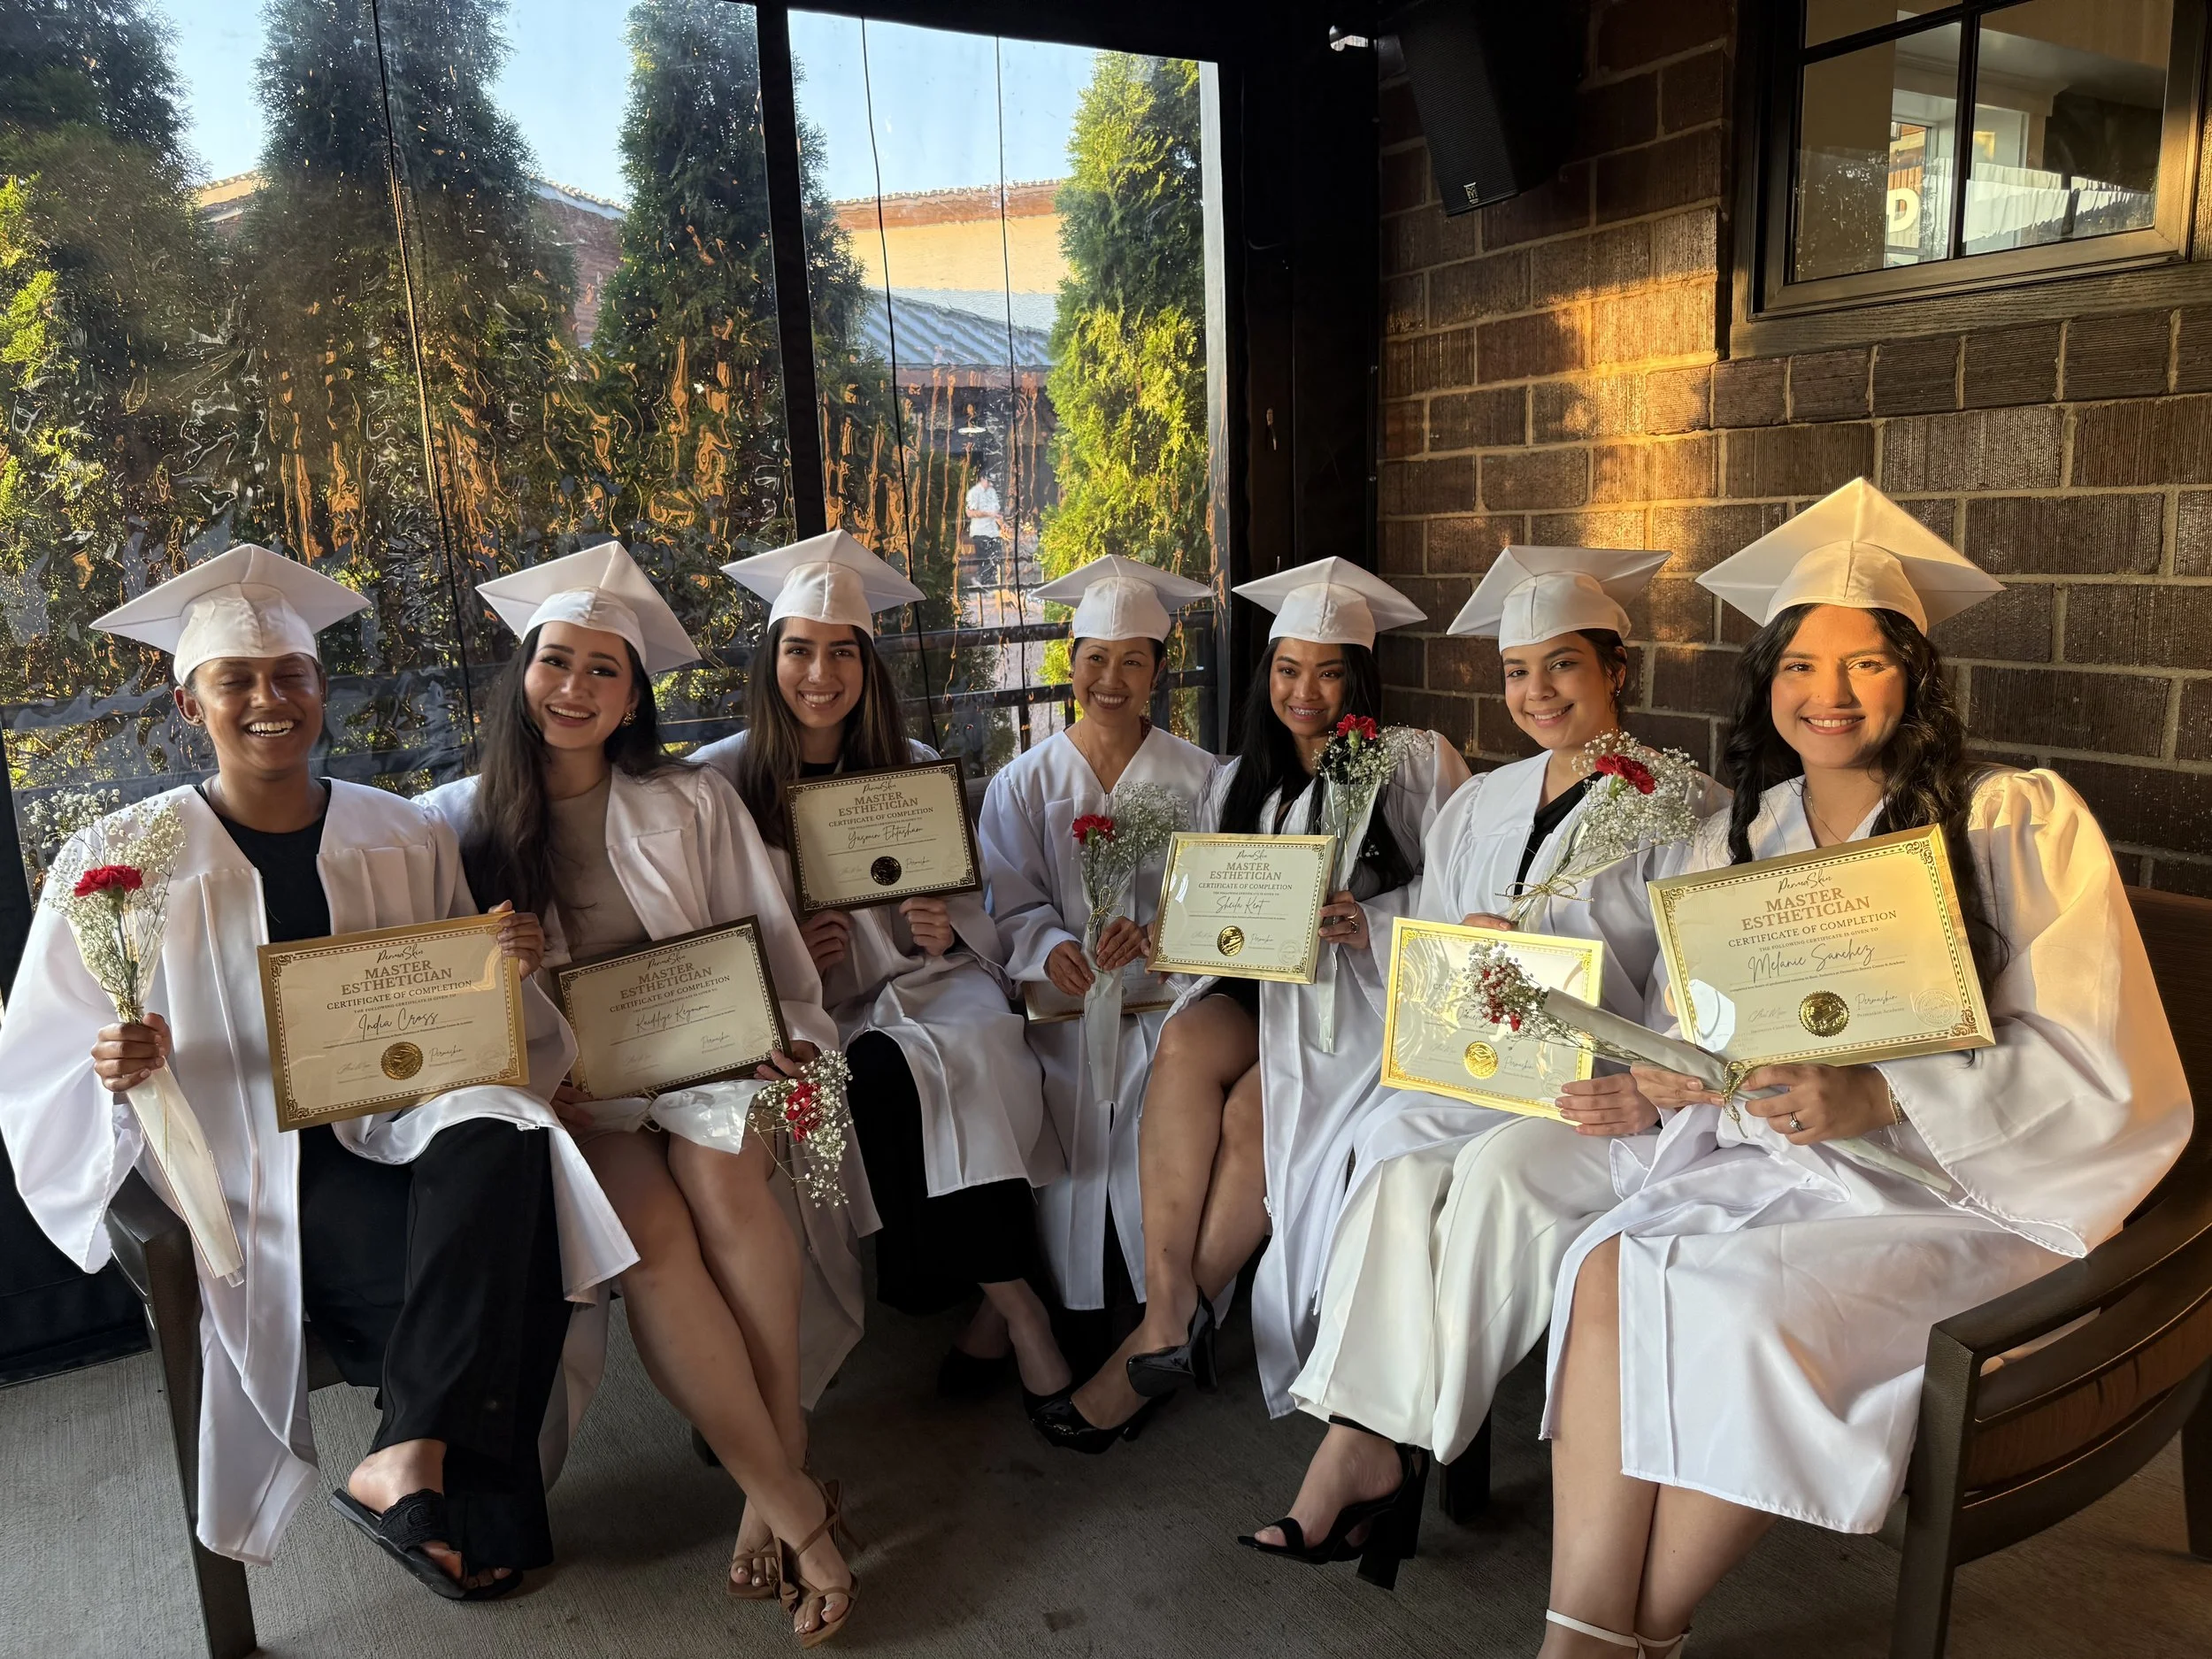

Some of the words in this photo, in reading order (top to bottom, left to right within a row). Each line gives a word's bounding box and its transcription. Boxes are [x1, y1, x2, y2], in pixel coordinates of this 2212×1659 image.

[839, 797, 918, 816] ESTHETICIAN
[855, 791, 902, 805] MASTER
[828, 816, 874, 827] CERTIFICATE
[887, 807, 933, 818] COMPLETION
[1210, 871, 1281, 880] ESTHETICIAN
[1766, 887, 1845, 912] MASTER
[1741, 895, 1870, 931] ESTHETICIAN
[1728, 927, 1800, 948] CERTIFICATE
[1802, 925, 1817, 934] OF
[1820, 910, 1897, 931] COMPLETION
[1771, 940, 1805, 950] FOLLOWING
[1806, 933, 1842, 945] CERTIFICATE
[365, 960, 433, 979] MASTER
[638, 962, 695, 985] MASTER
[1748, 952, 1807, 984] Melanie
[1811, 939, 1875, 972] Sanchez
[342, 968, 453, 995] ESTHETICIAN
[610, 995, 663, 1013] CERTIFICATE
[664, 989, 675, 998] OF
[677, 976, 730, 995] COMPLETION
[620, 967, 712, 999] ESTHETICIAN
[326, 993, 391, 1010] CERTIFICATE
[409, 980, 472, 996] COMPLETION
[358, 1014, 393, 1040] India
[398, 1007, 439, 1032] Cross
